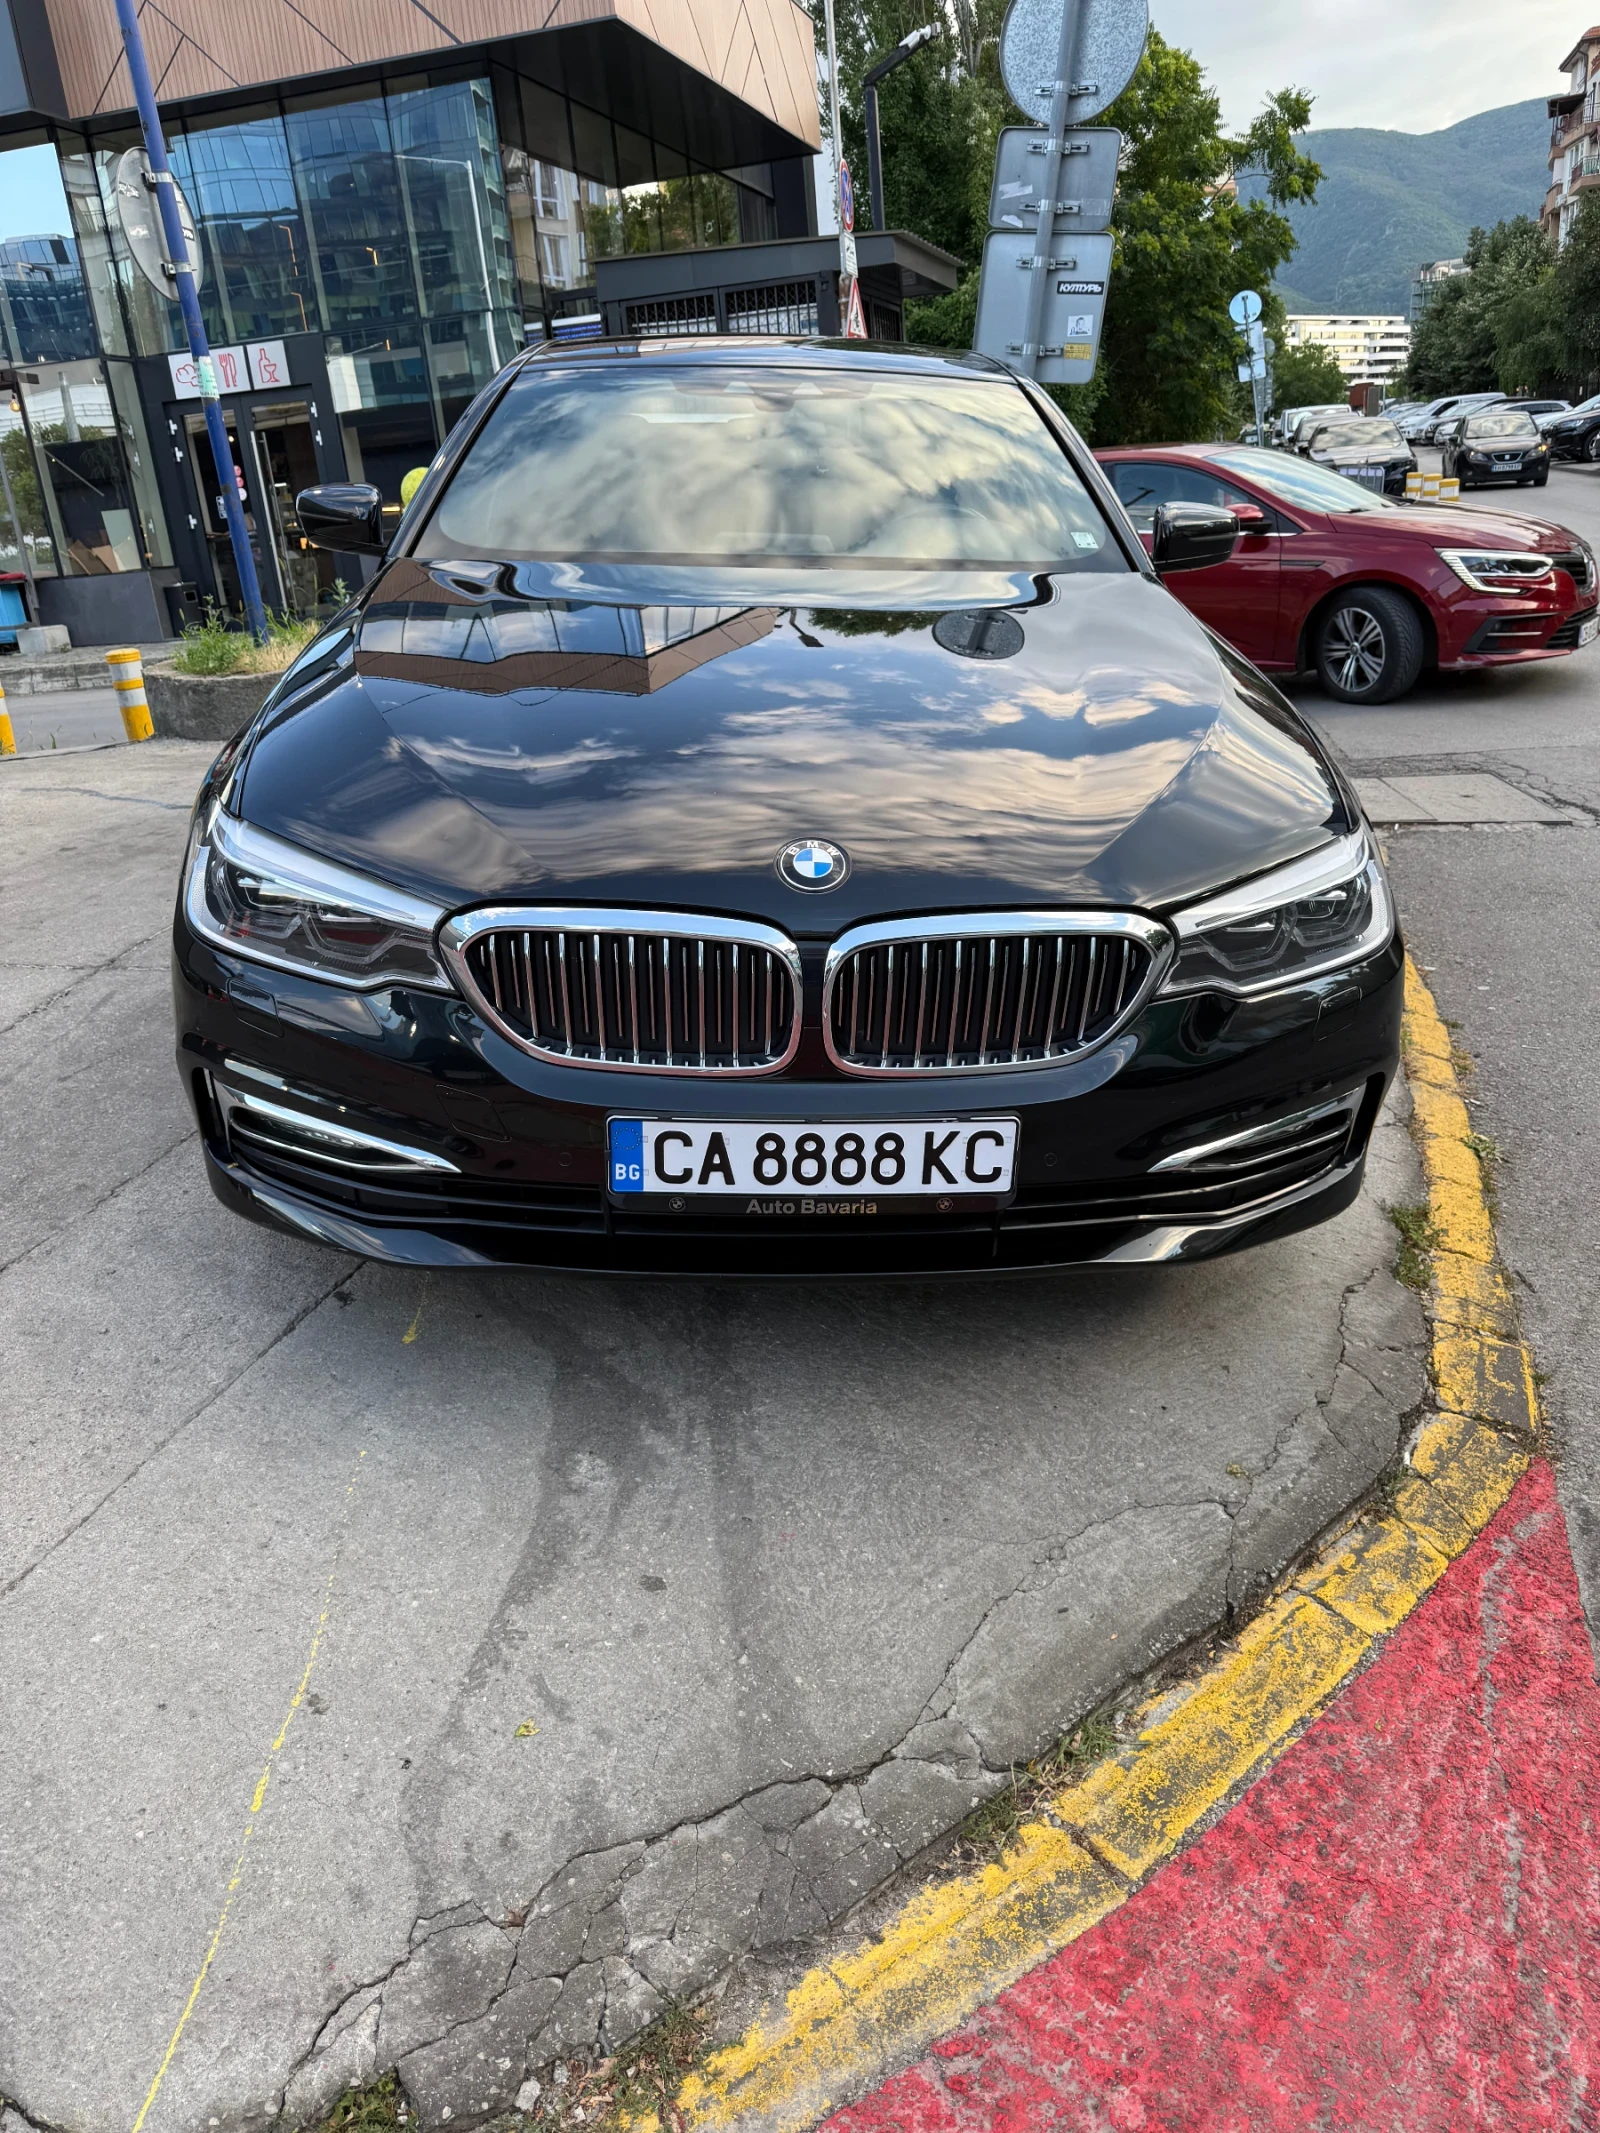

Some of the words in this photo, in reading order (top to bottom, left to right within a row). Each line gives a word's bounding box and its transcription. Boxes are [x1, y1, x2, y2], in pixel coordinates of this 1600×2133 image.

[788, 840, 840, 856] BMW
[654, 1130, 735, 1185] CA
[753, 1132, 905, 1186] 8888
[922, 1130, 1004, 1185] KC
[615, 1163, 640, 1180] BG
[746, 1199, 795, 1214] Auto
[801, 1199, 877, 1214] Bavaria
